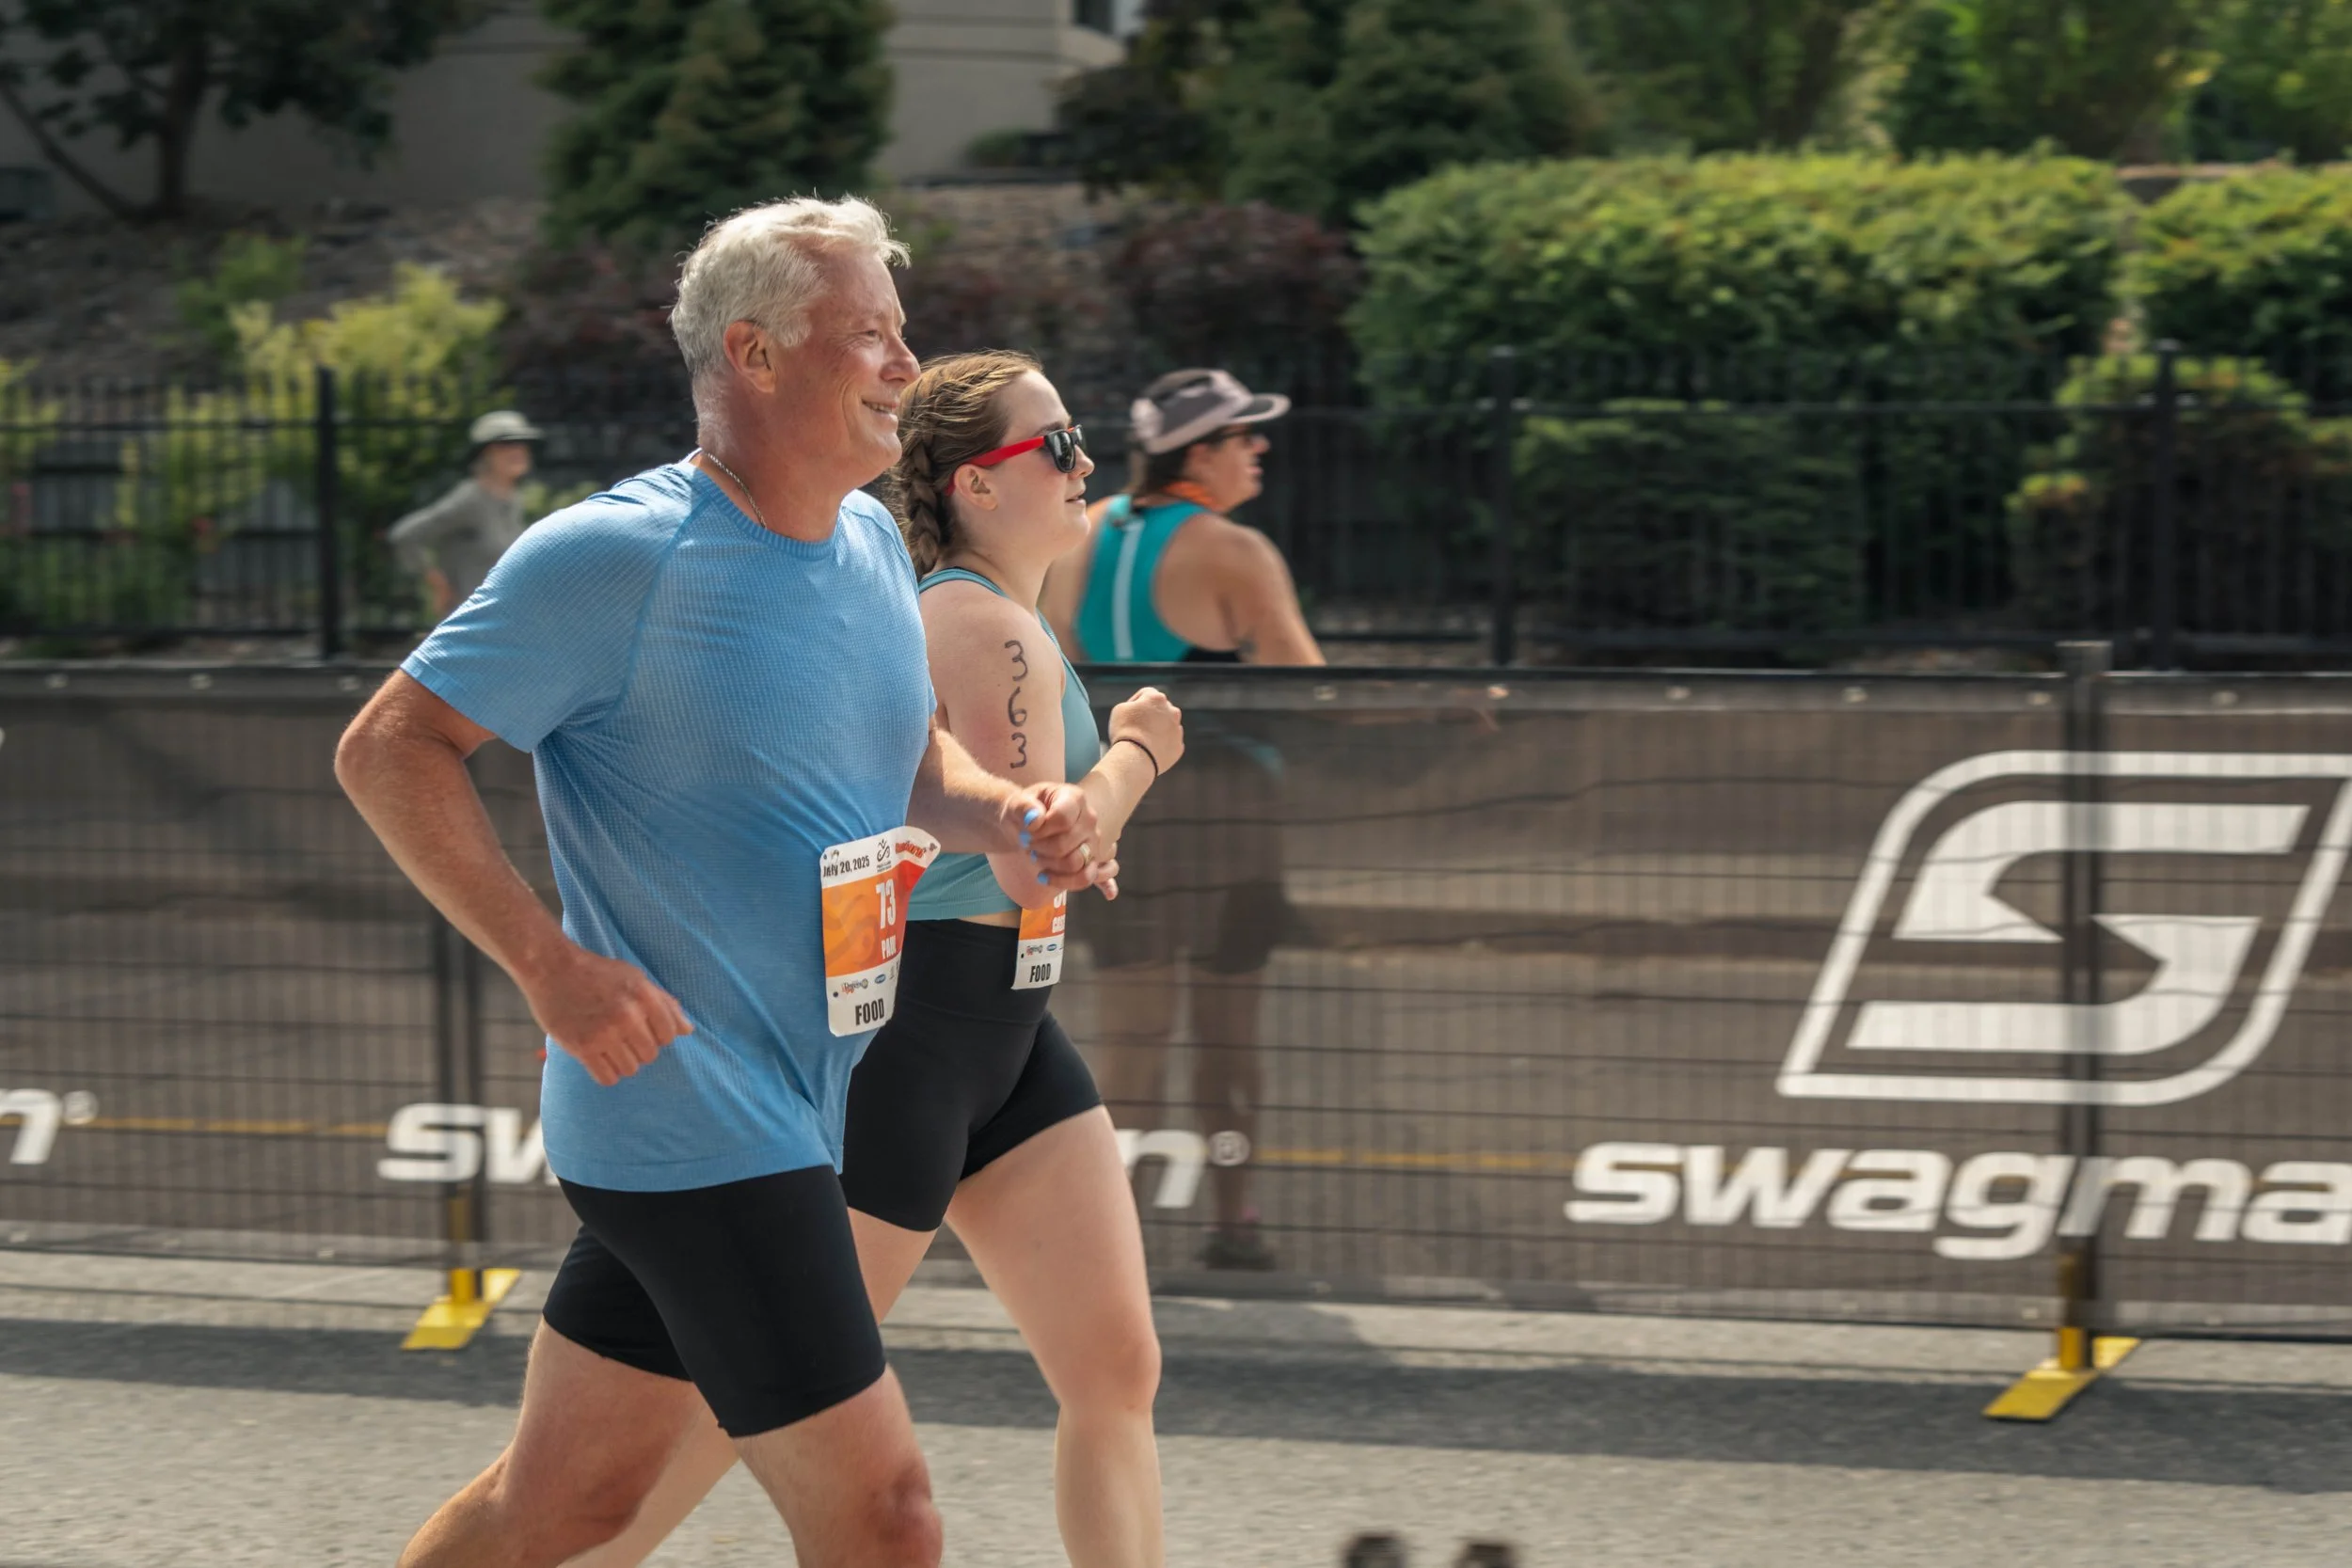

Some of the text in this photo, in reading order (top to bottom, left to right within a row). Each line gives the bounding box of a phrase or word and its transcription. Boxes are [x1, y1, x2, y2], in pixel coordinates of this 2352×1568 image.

[1004, 640, 1028, 769] 363
[823, 863, 838, 878] July
[853, 855, 870, 871] 2025
[875, 879, 897, 930] 73
[1029, 963, 1052, 983] FOOD
[854, 997, 885, 1025] FOOD
